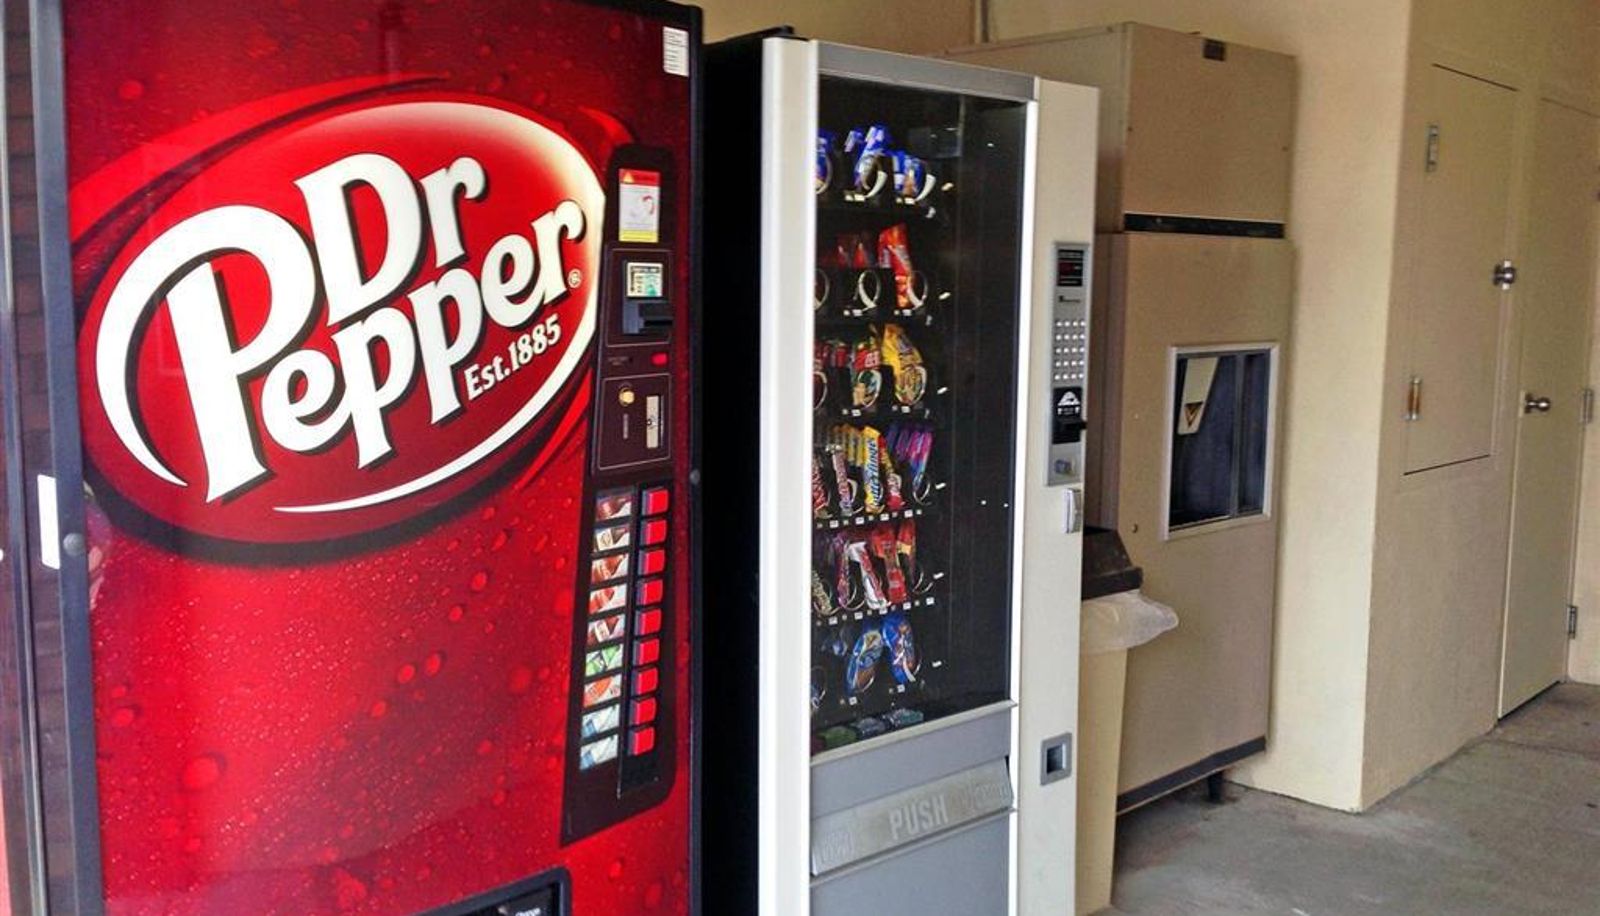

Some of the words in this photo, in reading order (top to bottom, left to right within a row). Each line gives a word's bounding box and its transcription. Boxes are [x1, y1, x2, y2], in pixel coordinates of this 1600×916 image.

[295, 153, 486, 326] Dr
[96, 200, 587, 503] Pepper
[888, 794, 949, 841] PUSH
